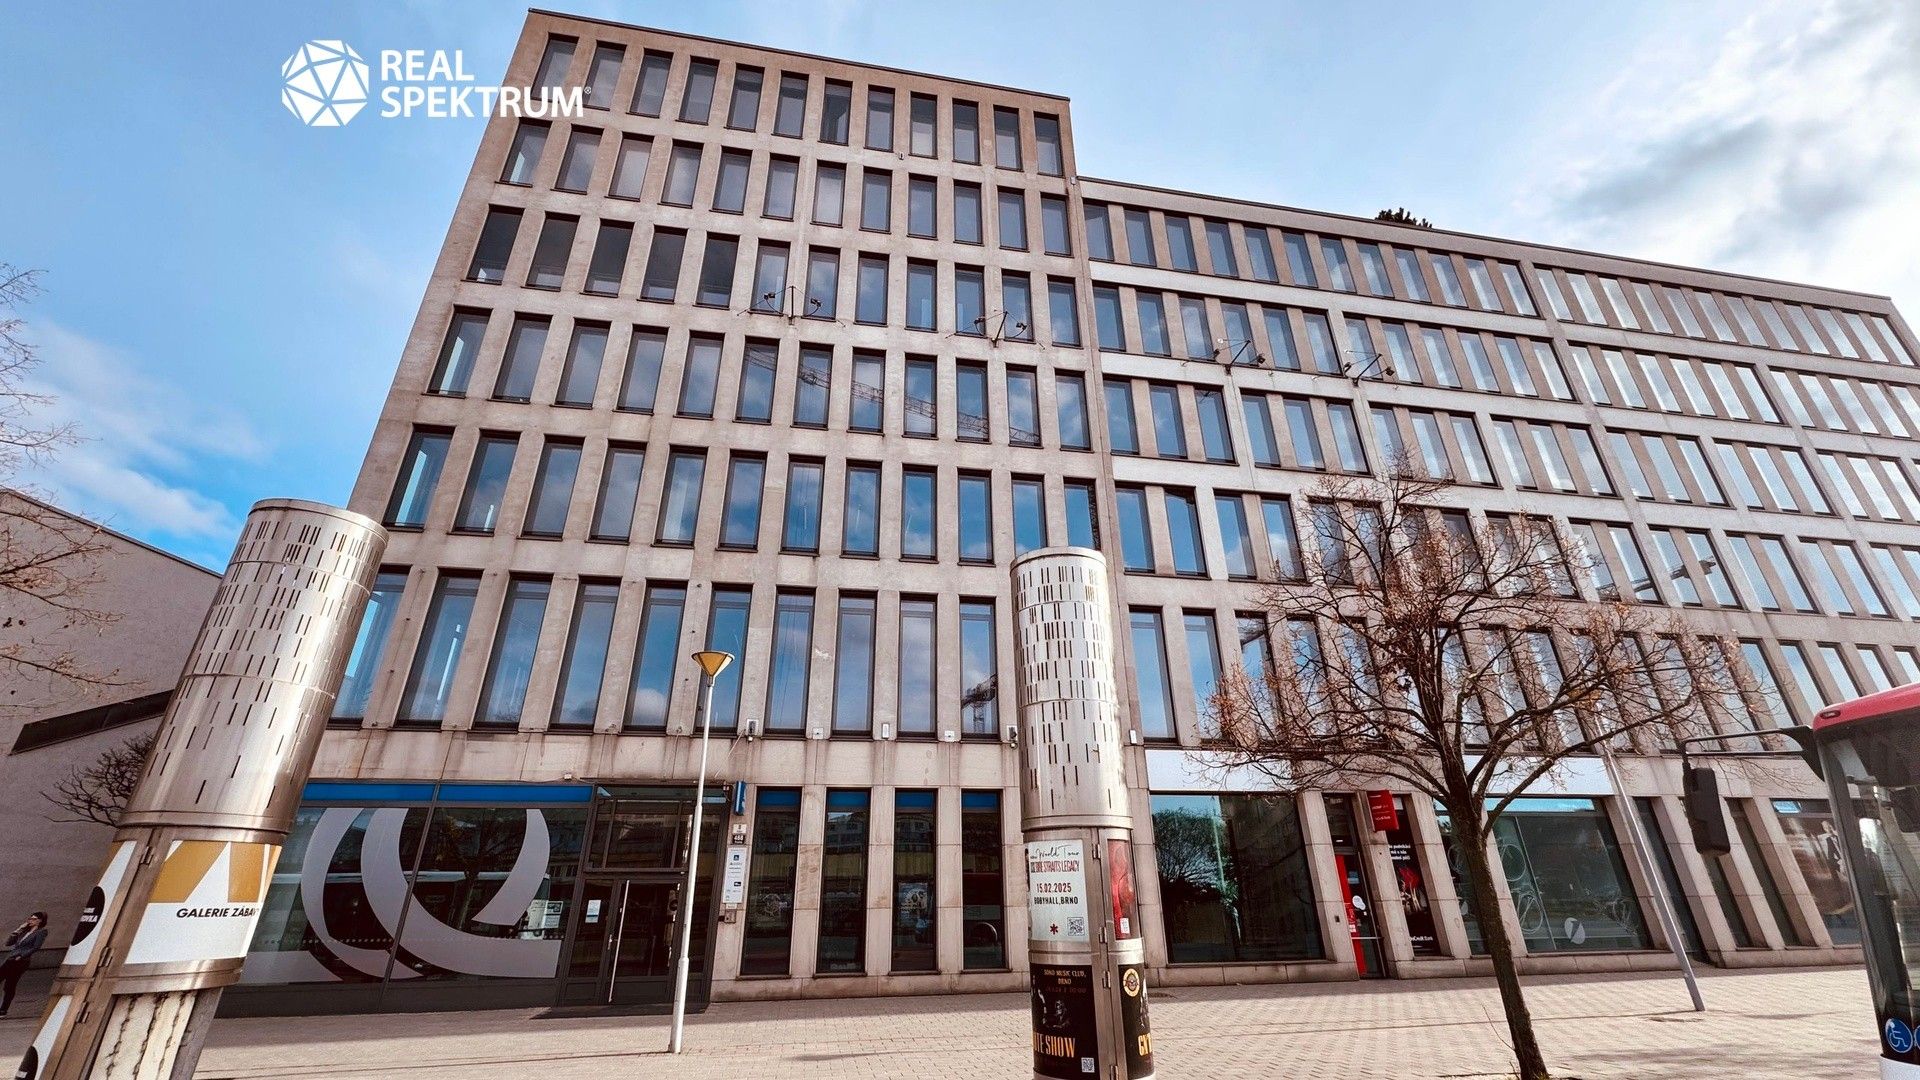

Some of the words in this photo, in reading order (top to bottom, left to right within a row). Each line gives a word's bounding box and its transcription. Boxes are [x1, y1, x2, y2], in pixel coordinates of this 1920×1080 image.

[1062, 860, 1080, 872] LEGACY
[1036, 883, 1072, 893] 15.02.2025
[176, 908, 230, 918] GALERIE
[1046, 1035, 1076, 1058] SHOW
